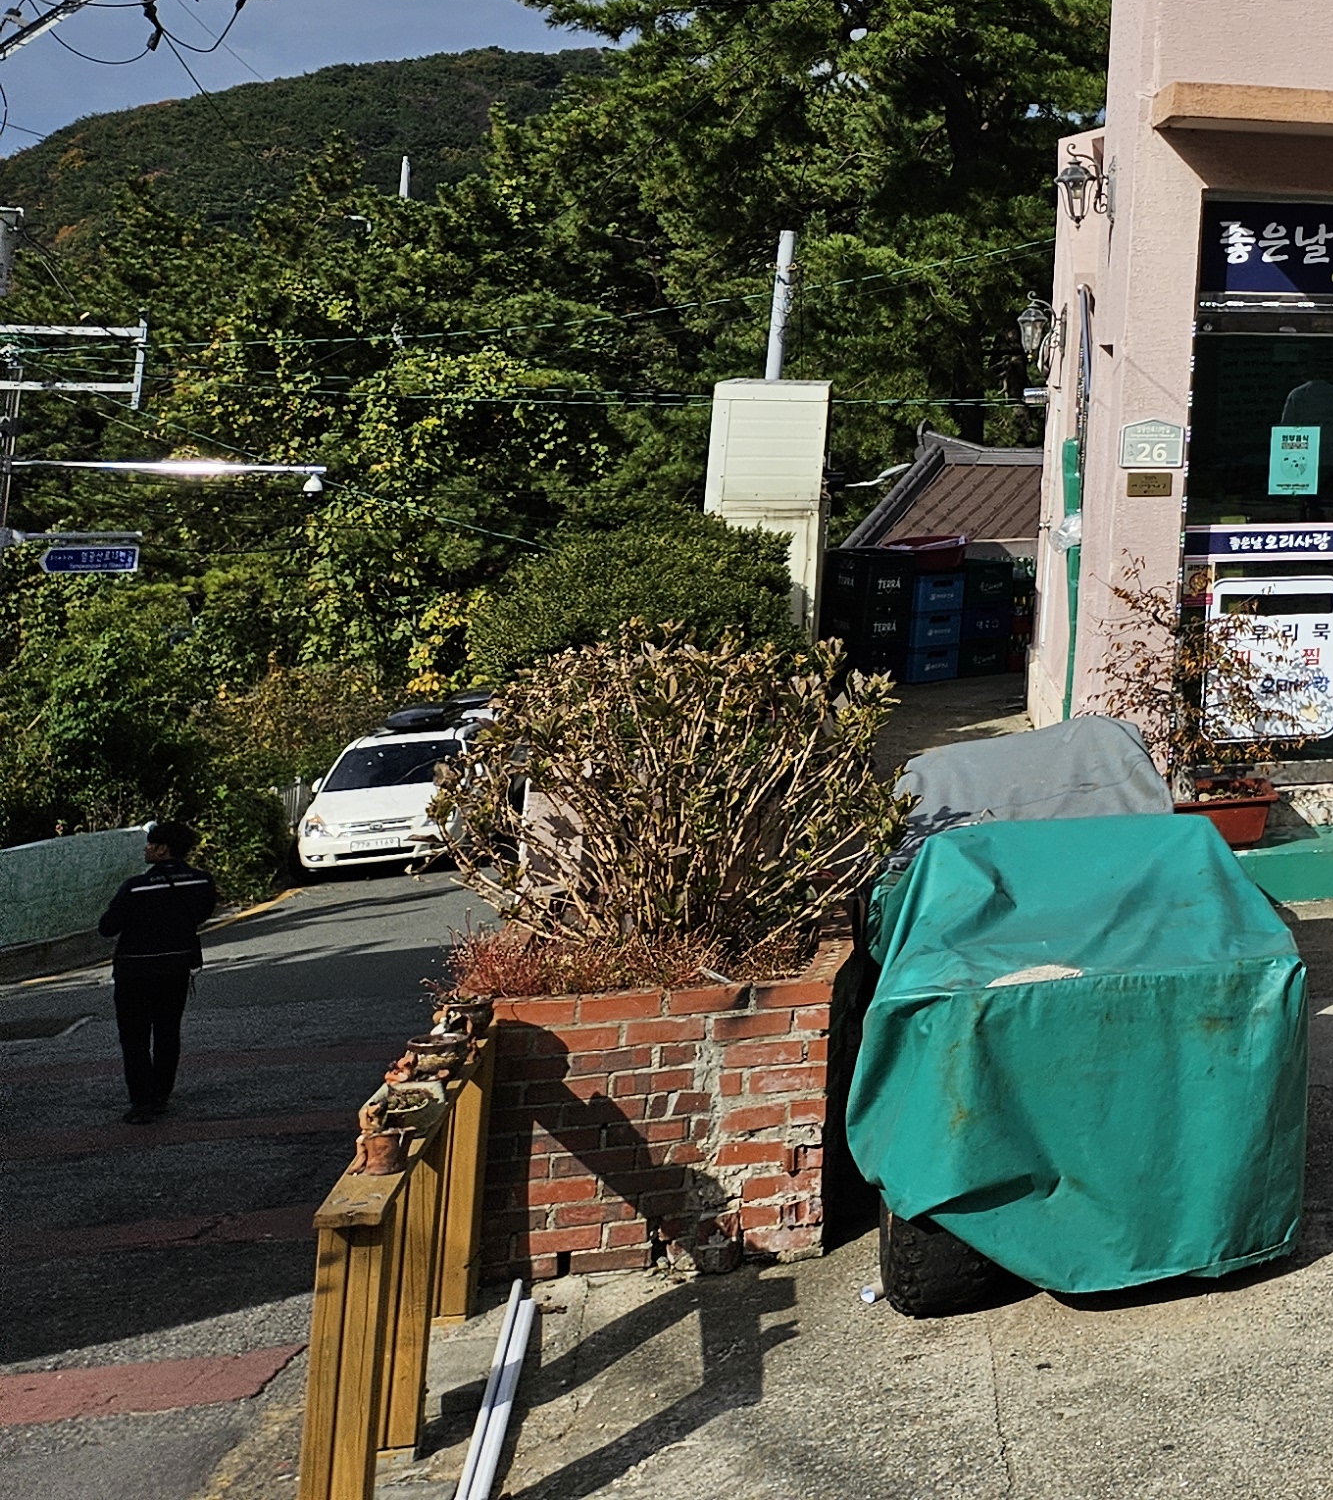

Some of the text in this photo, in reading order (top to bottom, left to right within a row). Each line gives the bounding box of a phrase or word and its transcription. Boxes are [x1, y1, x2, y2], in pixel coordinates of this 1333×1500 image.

[1219, 220, 1333, 265] 좋은날
[1135, 442, 1168, 463] 26
[1264, 531, 1332, 551] 오리사랑
[877, 576, 901, 591] TERRA
[872, 618, 897, 634] TERRA
